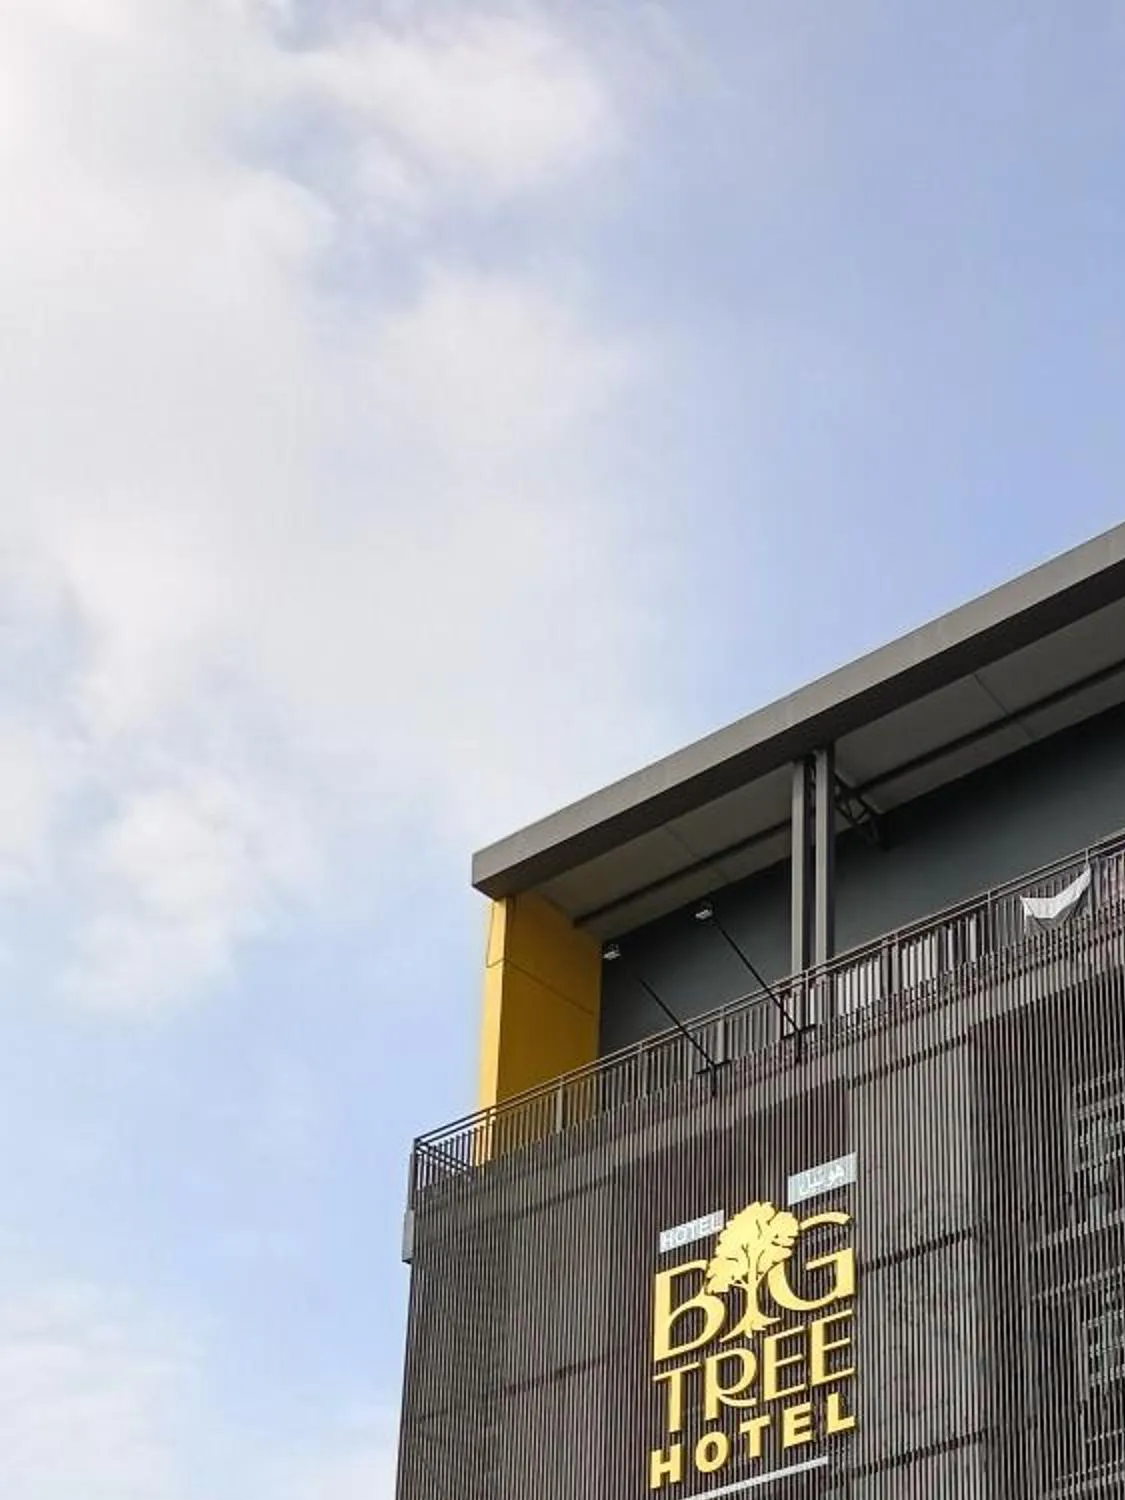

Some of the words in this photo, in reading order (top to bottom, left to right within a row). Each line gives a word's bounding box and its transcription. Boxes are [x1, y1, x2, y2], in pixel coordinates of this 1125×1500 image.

[664, 1214, 720, 1251] HOTEL
[653, 1309, 855, 1433] TREE
[649, 1393, 855, 1490] HOTEL
